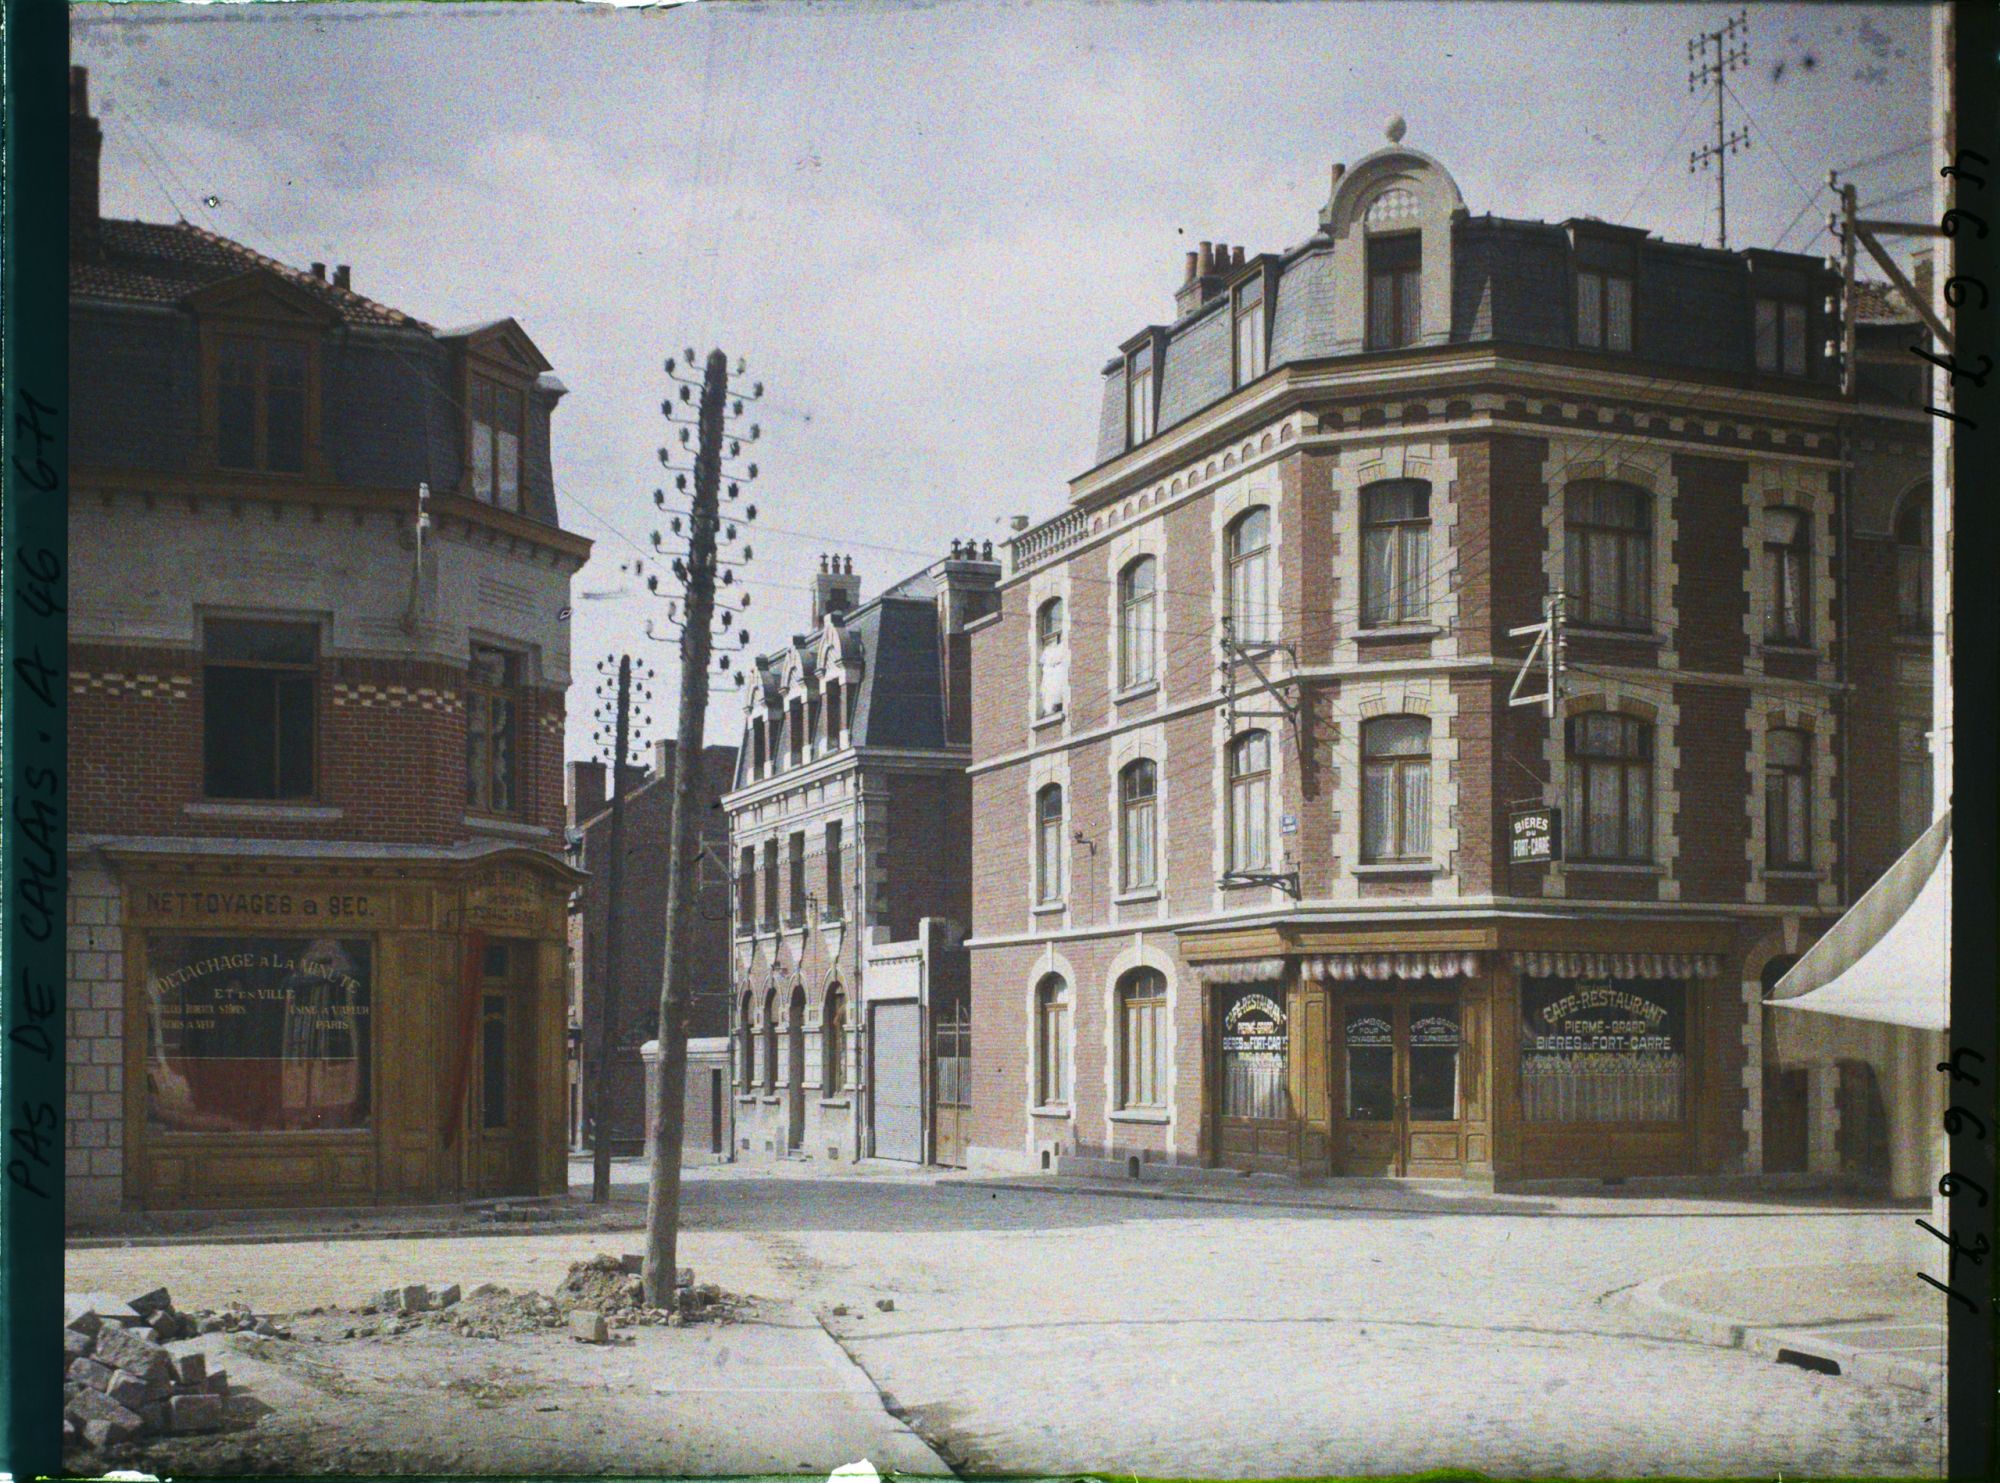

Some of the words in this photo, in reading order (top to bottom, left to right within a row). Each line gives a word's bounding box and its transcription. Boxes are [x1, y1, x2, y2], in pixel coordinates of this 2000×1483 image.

[14, 639, 60, 710] A
[146, 892, 292, 915] NETTOYAGES
[214, 987, 234, 1000] ET
[256, 987, 296, 1000] VILLE
[301, 957, 361, 995] MINUTE
[18, 967, 57, 1063] DE
[315, 1020, 350, 1030] PARIS
[10, 1099, 59, 1199] PAS
